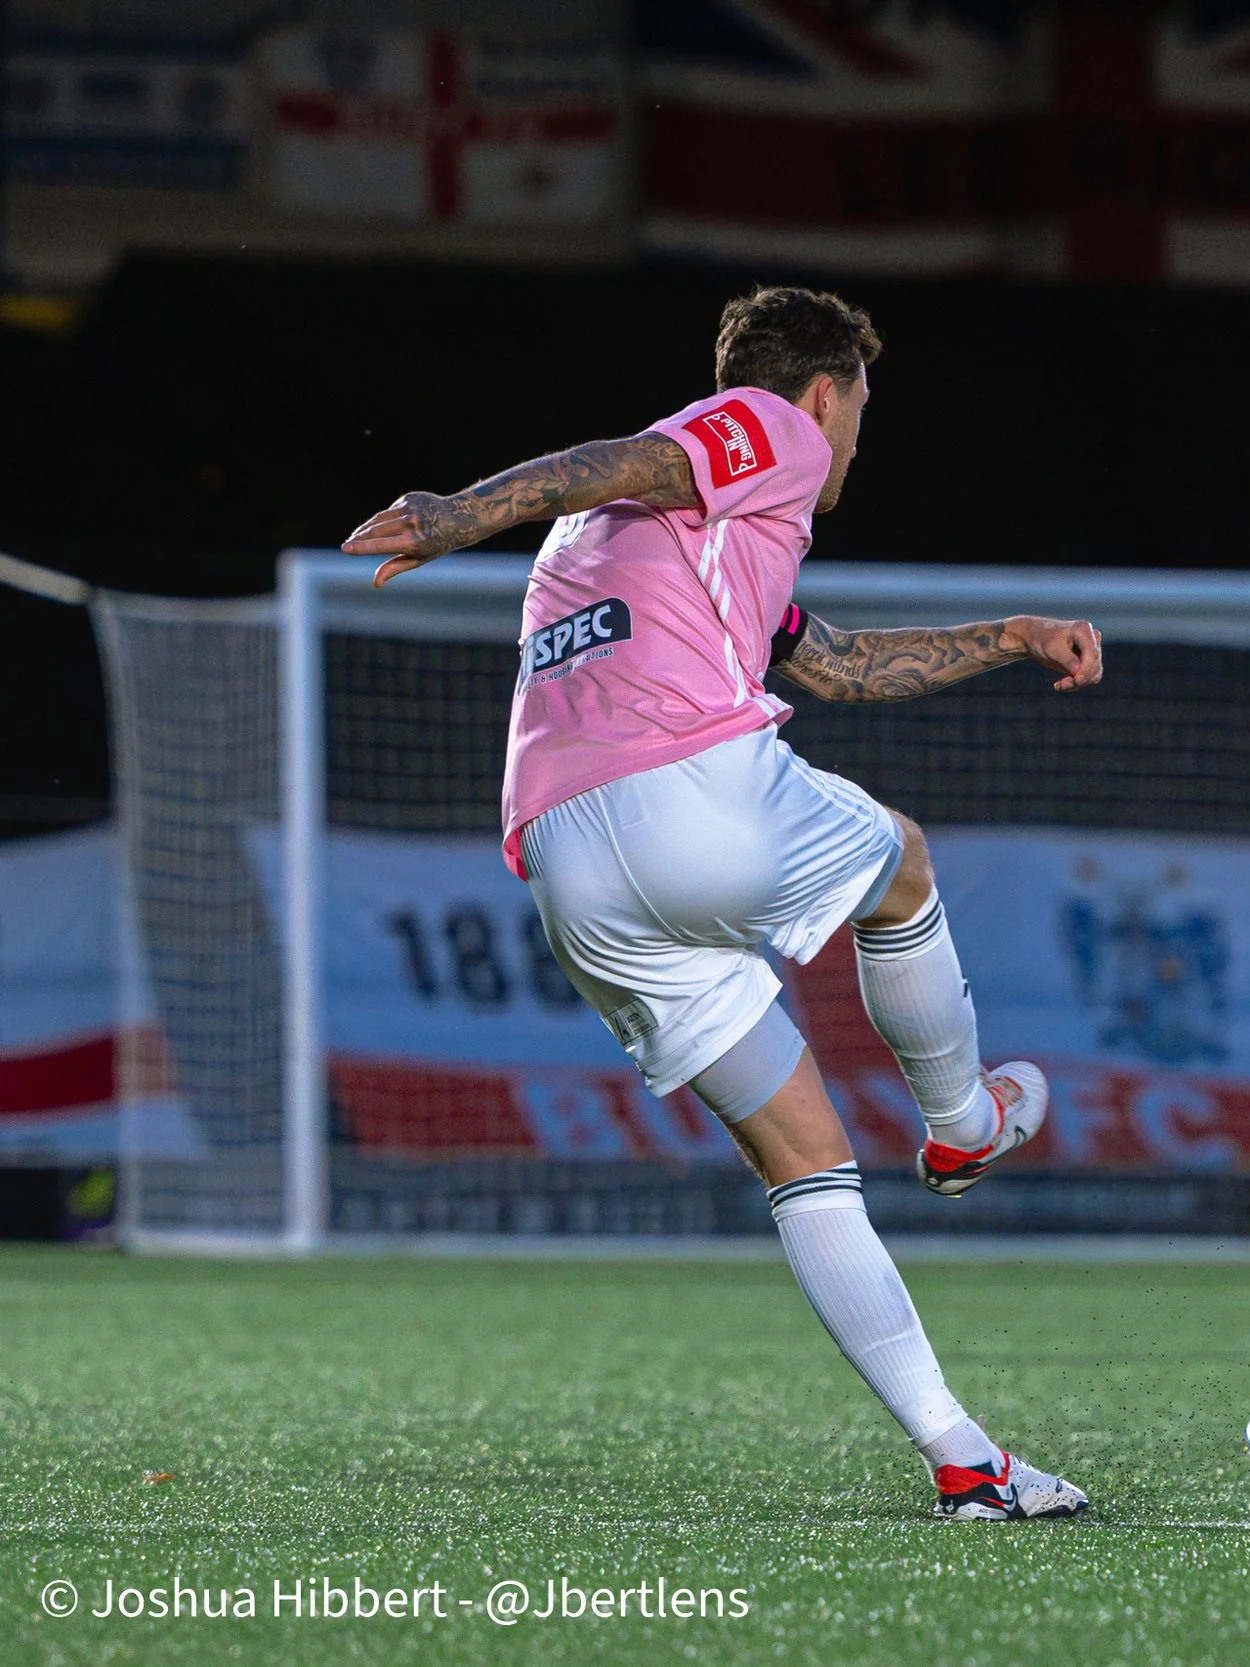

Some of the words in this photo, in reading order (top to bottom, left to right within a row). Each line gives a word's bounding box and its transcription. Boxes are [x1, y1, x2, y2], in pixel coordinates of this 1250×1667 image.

[720, 418, 752, 461] PITCHING
[726, 436, 741, 451] IN
[1050, 1080, 1234, 1170] FC
